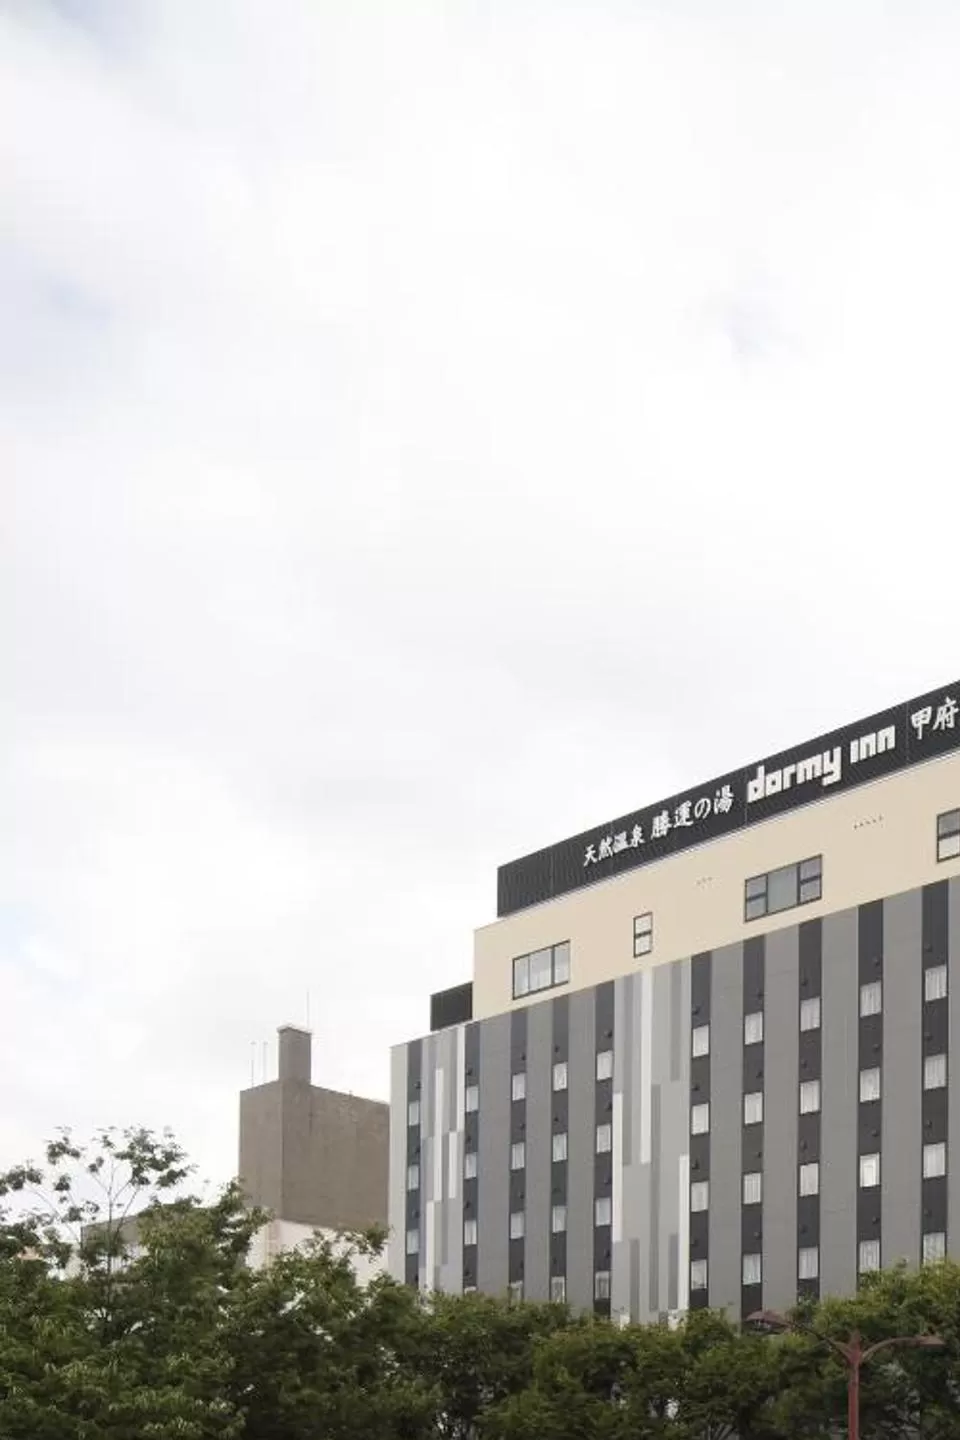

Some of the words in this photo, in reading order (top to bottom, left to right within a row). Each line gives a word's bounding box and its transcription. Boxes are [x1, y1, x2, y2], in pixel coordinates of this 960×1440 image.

[747, 746, 842, 803] dormy
[850, 724, 896, 764] inn
[583, 823, 645, 867] 天然温泉
[651, 784, 734, 840] 勝運の湯
